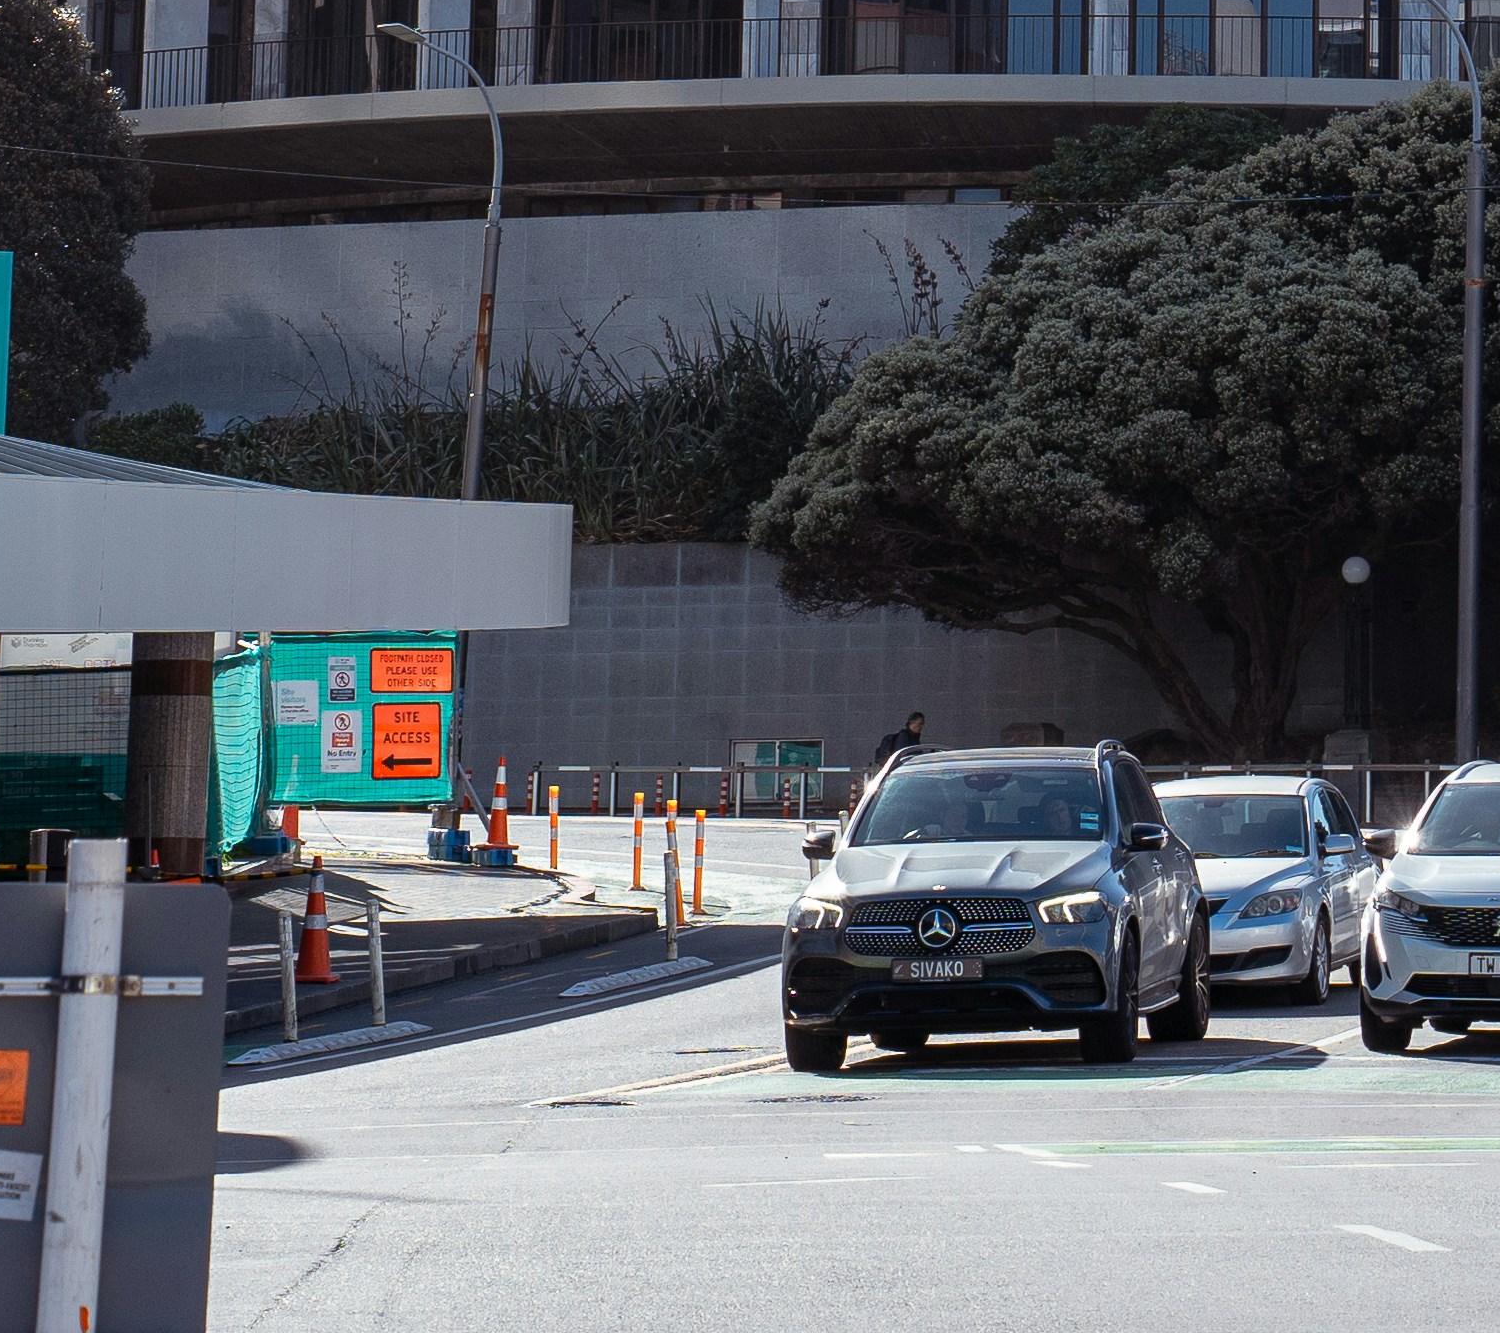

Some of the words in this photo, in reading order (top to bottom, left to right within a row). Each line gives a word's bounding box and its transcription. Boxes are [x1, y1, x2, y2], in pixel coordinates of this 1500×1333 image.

[380, 654, 414, 663] FOOTPATH
[417, 654, 444, 663] CLOSED
[386, 666, 417, 675] PLEASE
[421, 666, 438, 675] USE
[387, 678, 414, 688] OTHER
[418, 678, 437, 688] SIDE
[394, 711, 420, 723] SITE
[383, 732, 431, 744] ACCESS
[910, 960, 964, 978] SIVAKO
[1477, 958, 1496, 973] TW
